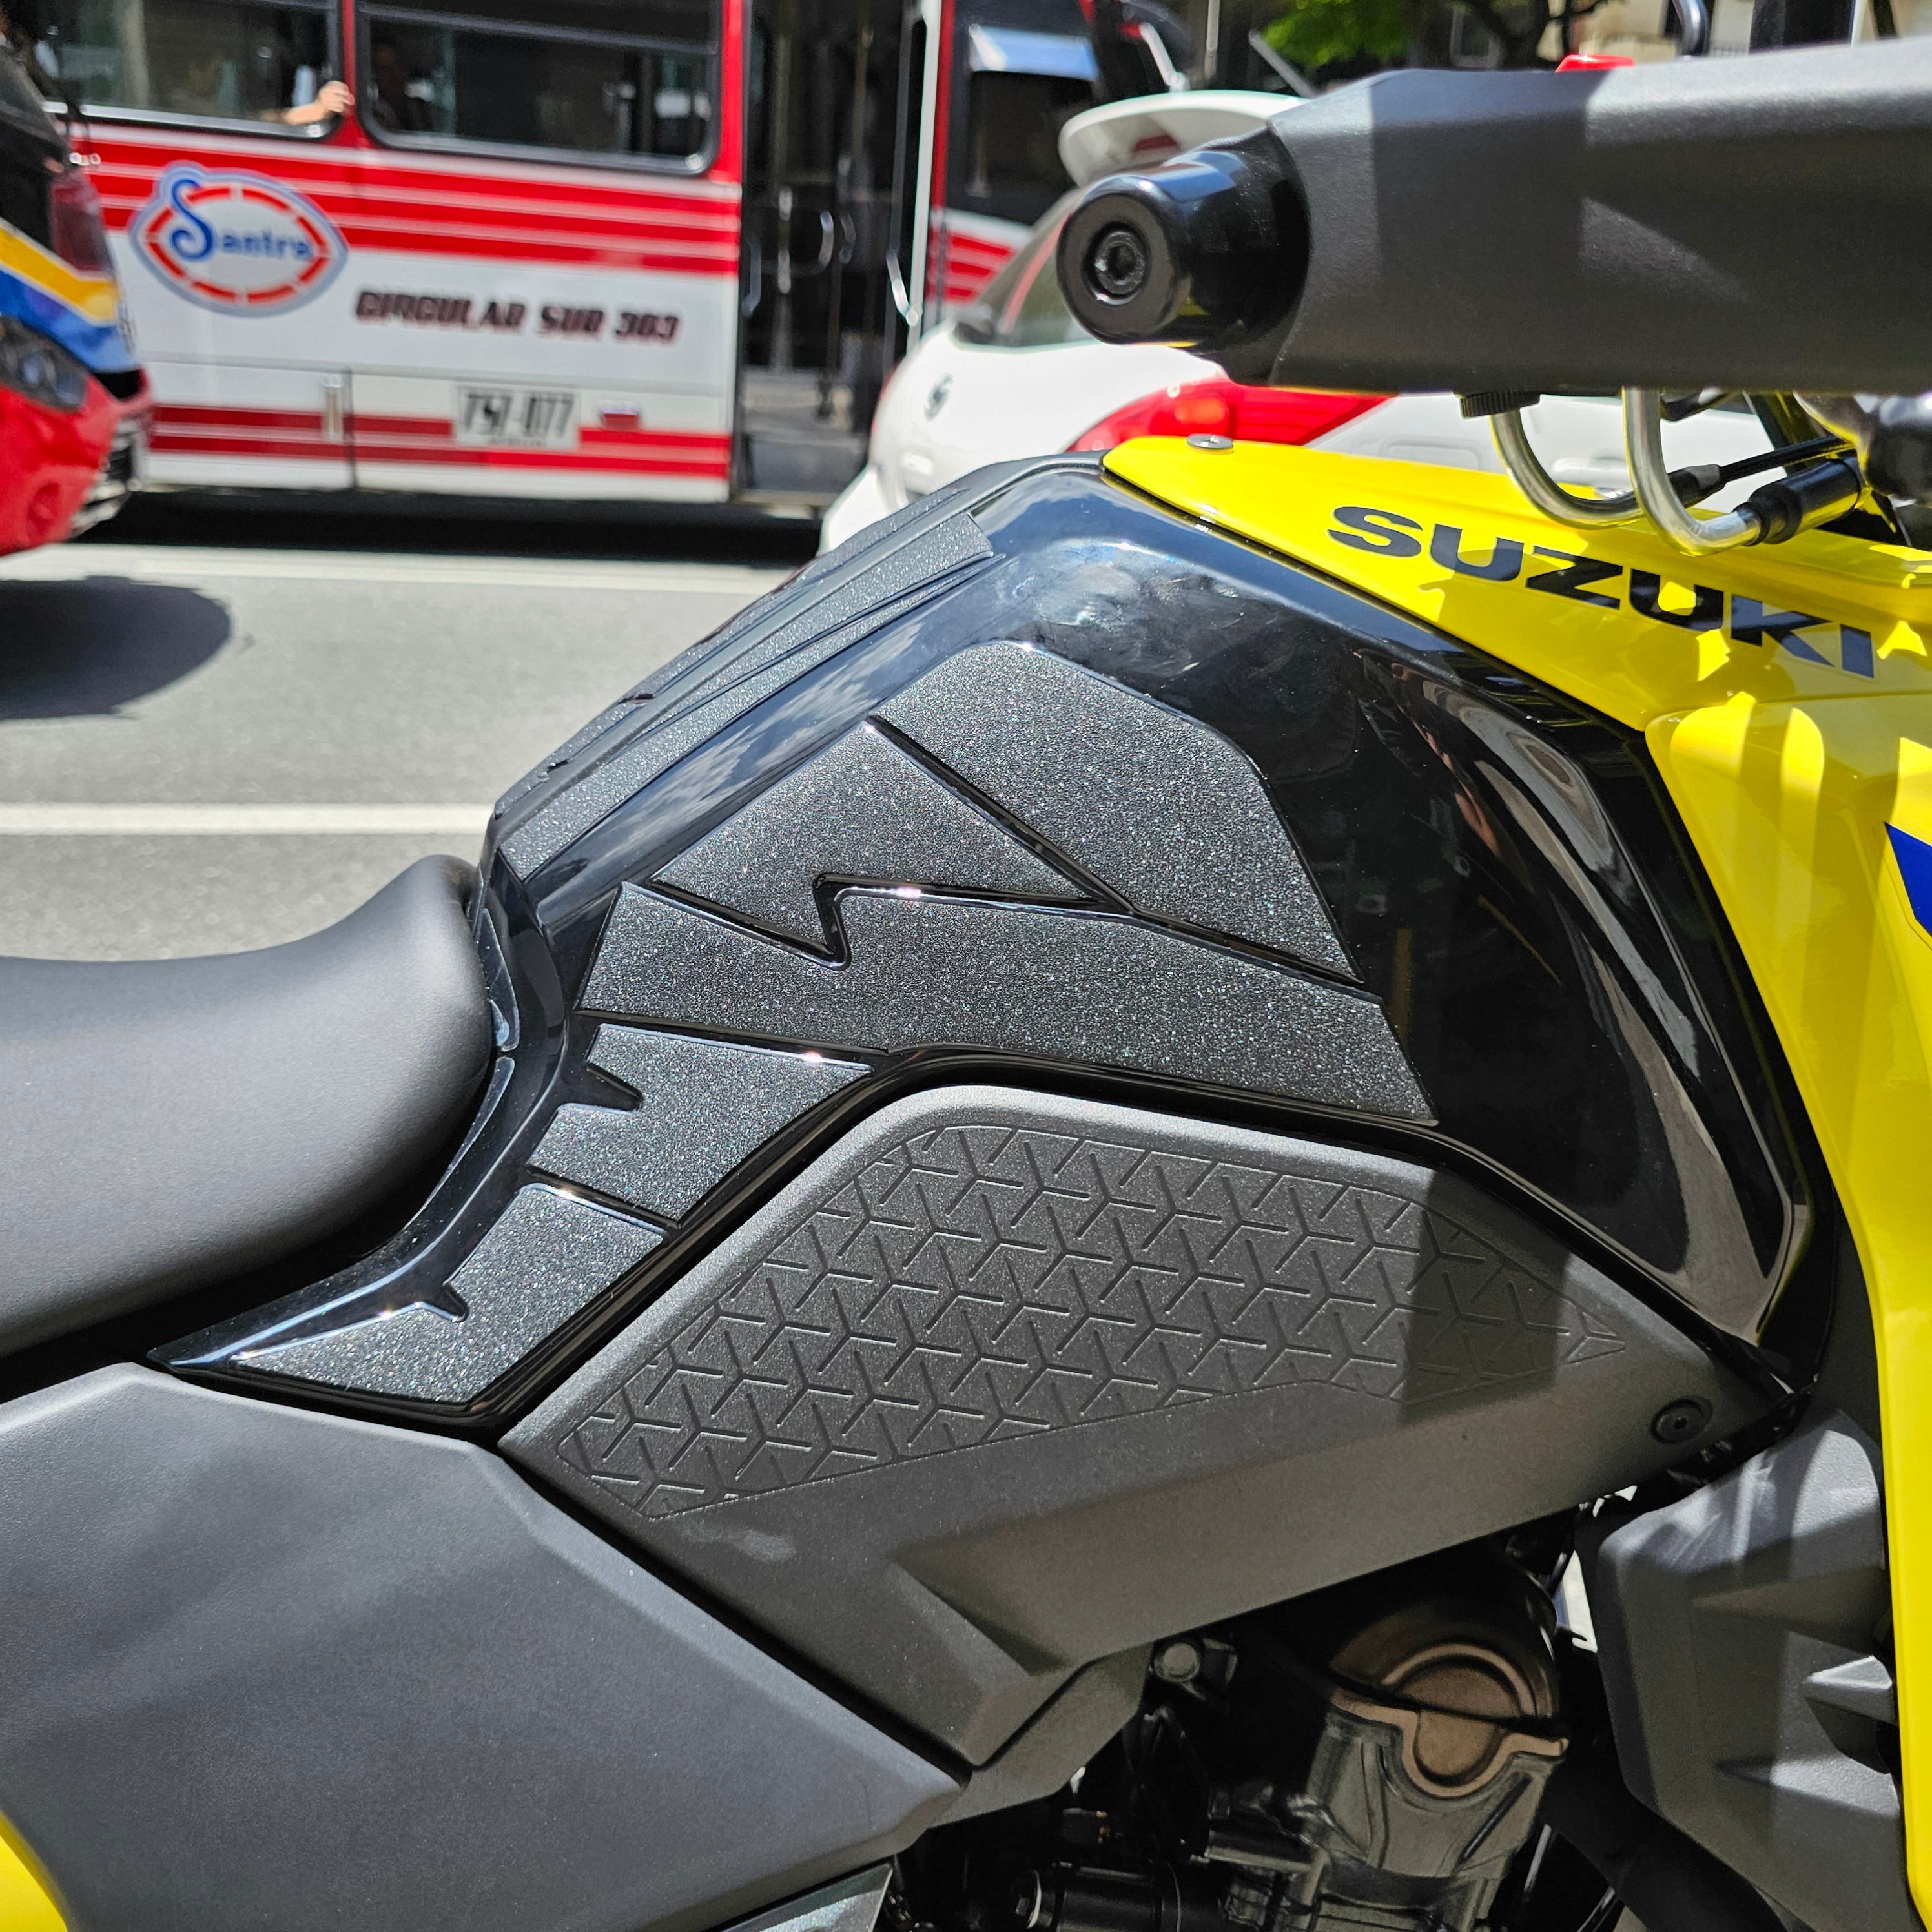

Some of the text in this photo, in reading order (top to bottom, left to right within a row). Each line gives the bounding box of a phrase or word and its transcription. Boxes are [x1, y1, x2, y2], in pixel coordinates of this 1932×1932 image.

[170, 177, 312, 261] Santra
[540, 305, 604, 338] SUR
[1327, 505, 1876, 678] SUZUKI
